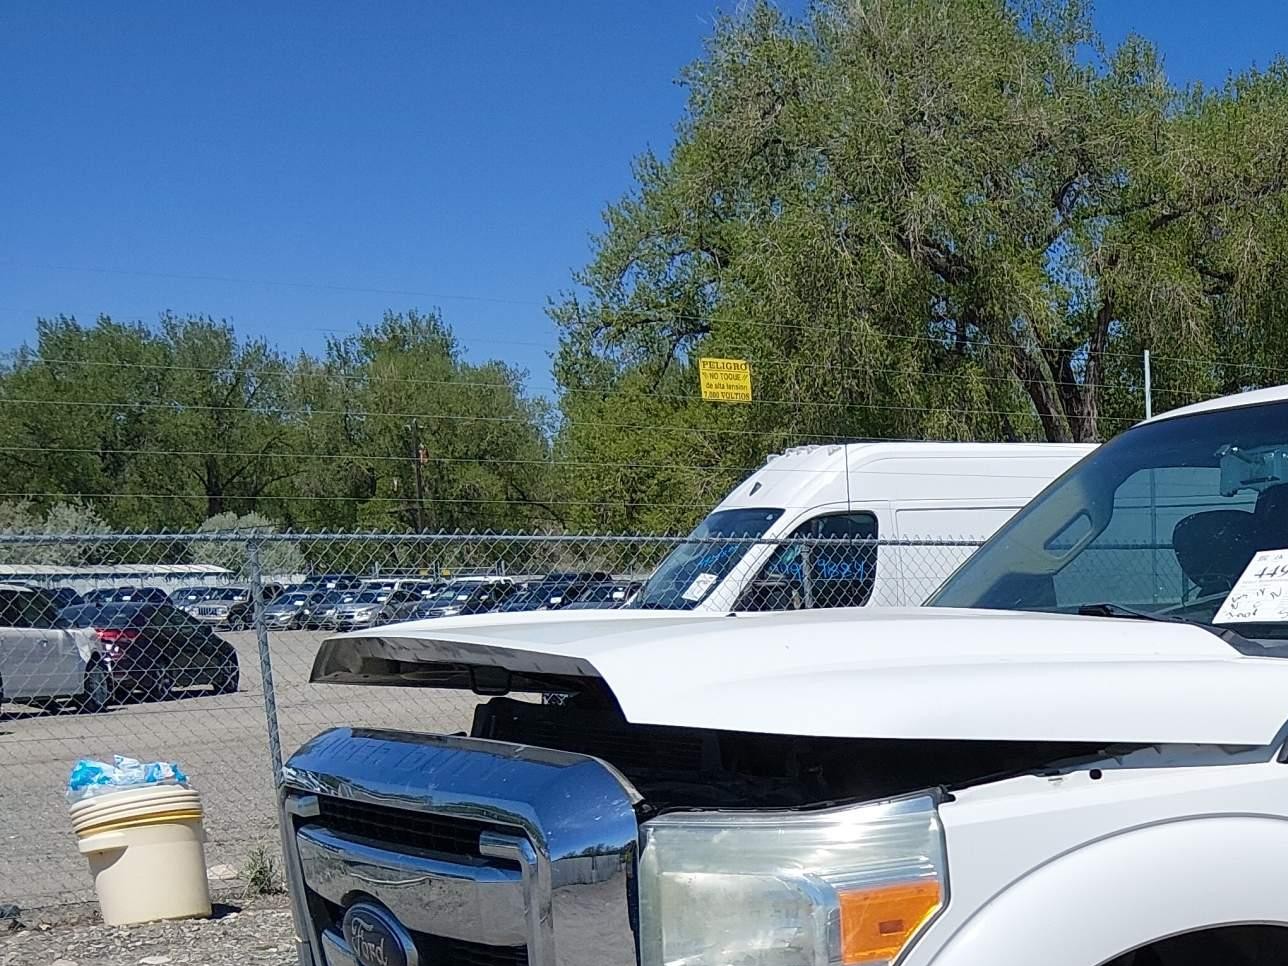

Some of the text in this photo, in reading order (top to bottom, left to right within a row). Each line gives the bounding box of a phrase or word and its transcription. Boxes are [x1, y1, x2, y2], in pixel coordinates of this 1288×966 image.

[702, 361, 748, 370] PELIGRO
[709, 372, 741, 381] NO TOQUE
[720, 391, 750, 400] VOLTIOS
[351, 917, 388, 966] Ford
